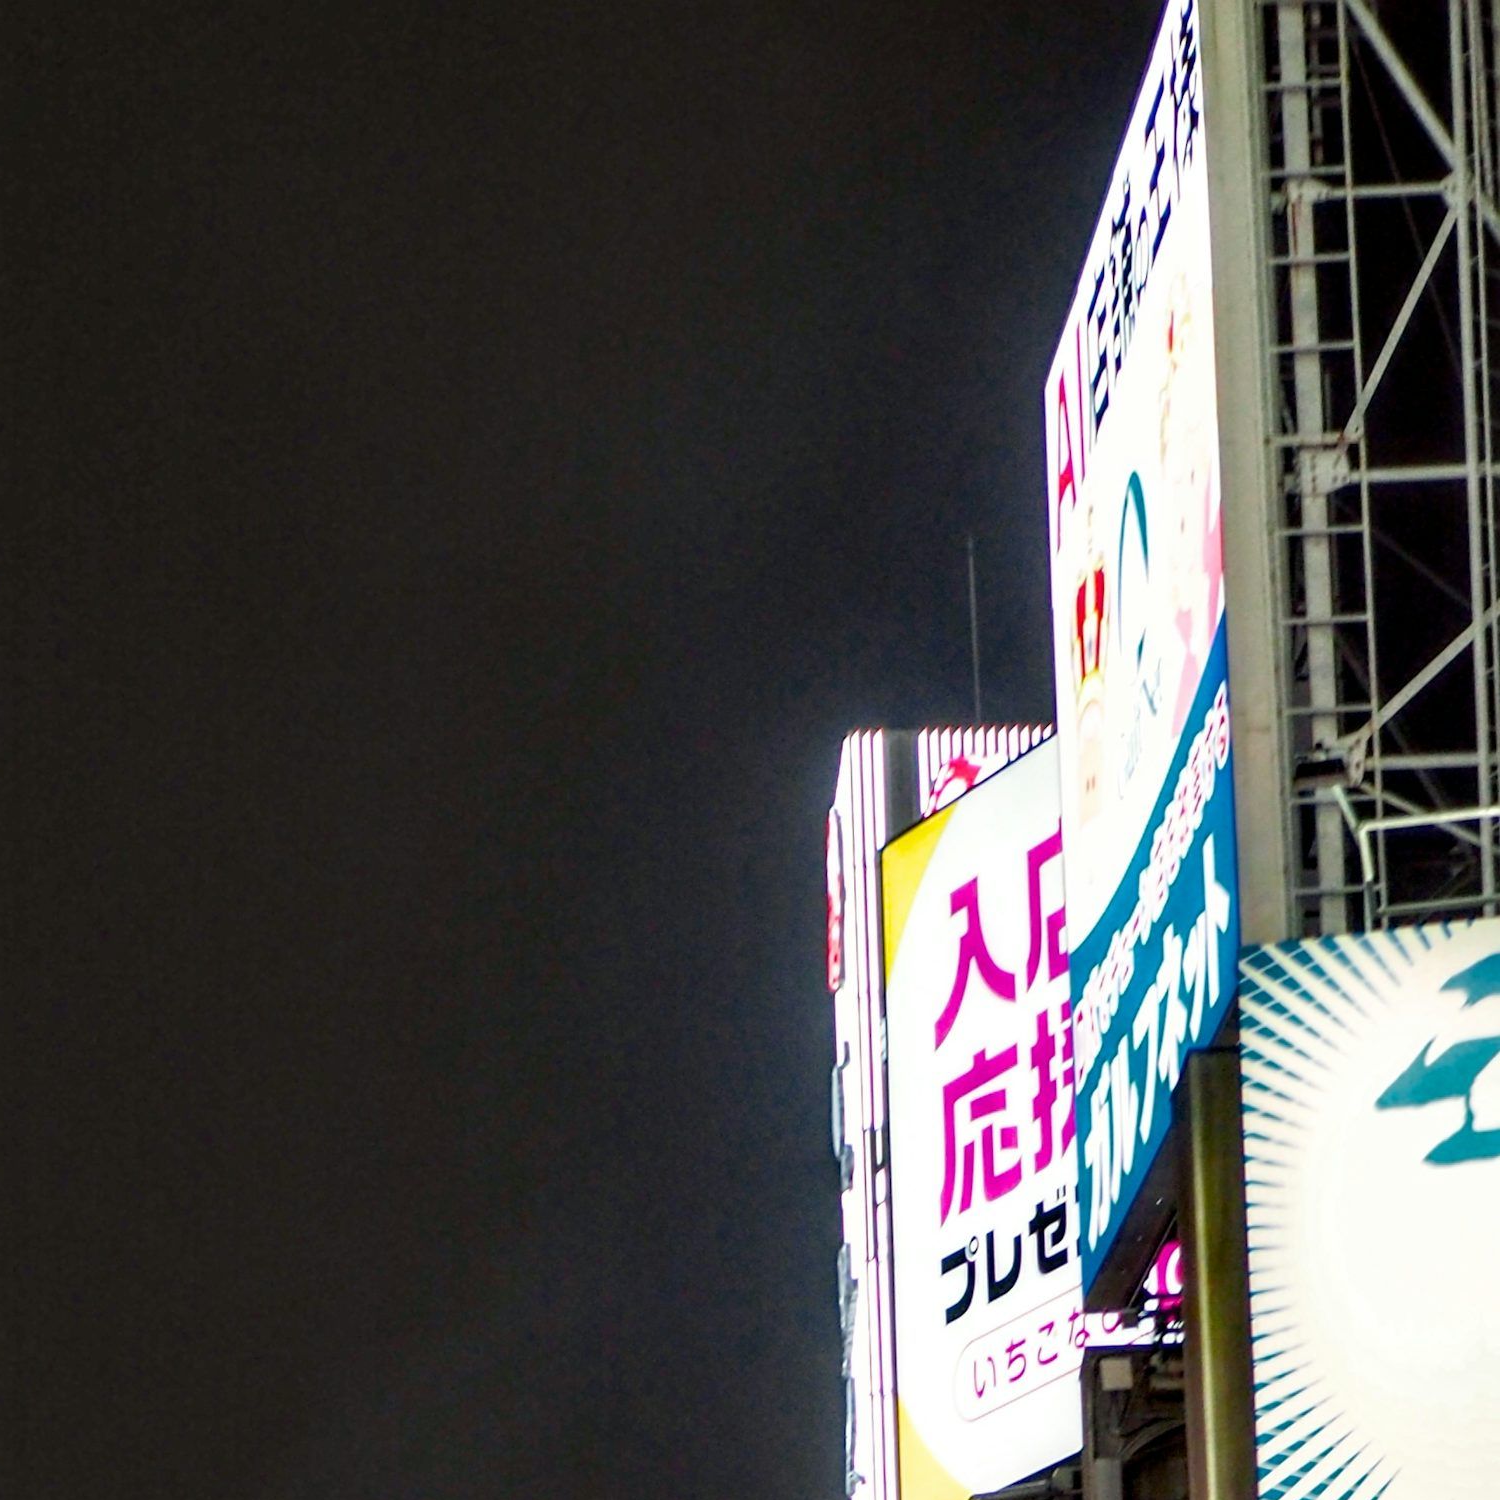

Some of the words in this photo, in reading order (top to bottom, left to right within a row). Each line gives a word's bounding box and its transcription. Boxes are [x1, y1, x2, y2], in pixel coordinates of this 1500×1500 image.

[1084, 834, 1230, 1252] ガルフネット
[940, 1184, 1080, 1326] プレゼ
